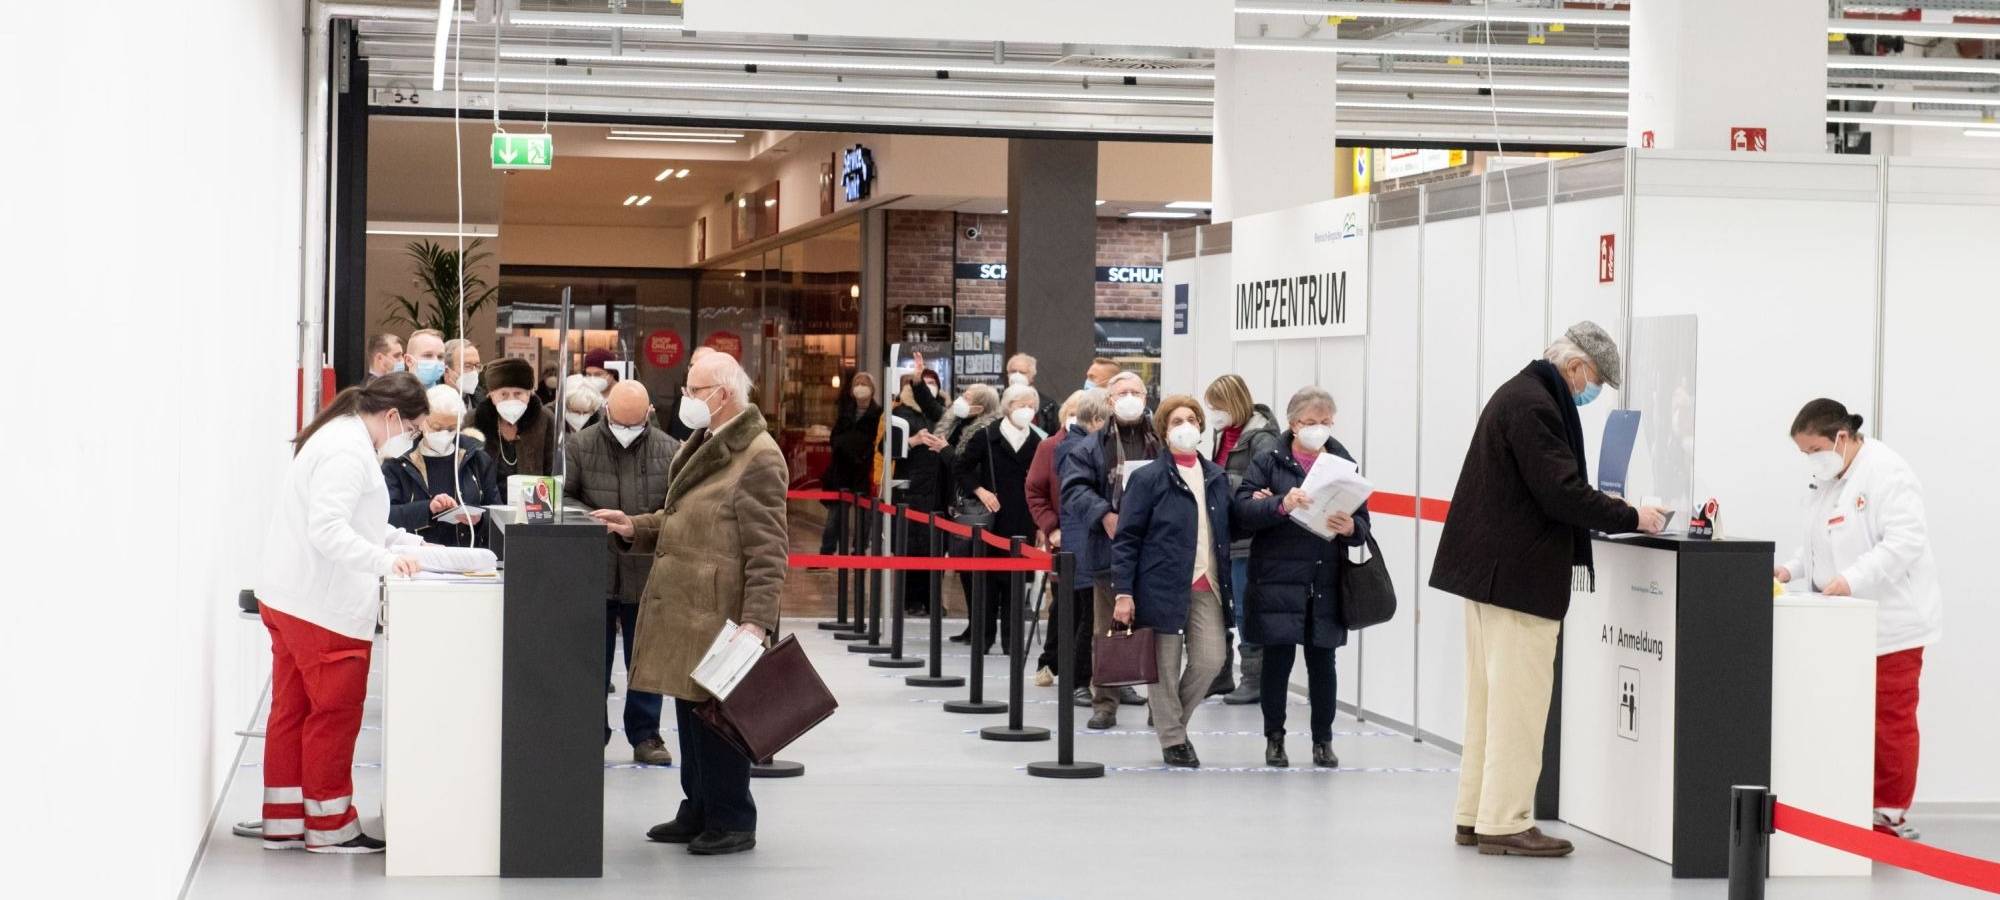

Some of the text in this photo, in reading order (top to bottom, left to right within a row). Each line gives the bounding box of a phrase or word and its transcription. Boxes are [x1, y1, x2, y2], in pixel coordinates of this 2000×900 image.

[1235, 270, 1347, 331] IMPFZENTRUM
[1601, 623, 1663, 662] A 1 Anmeldung
